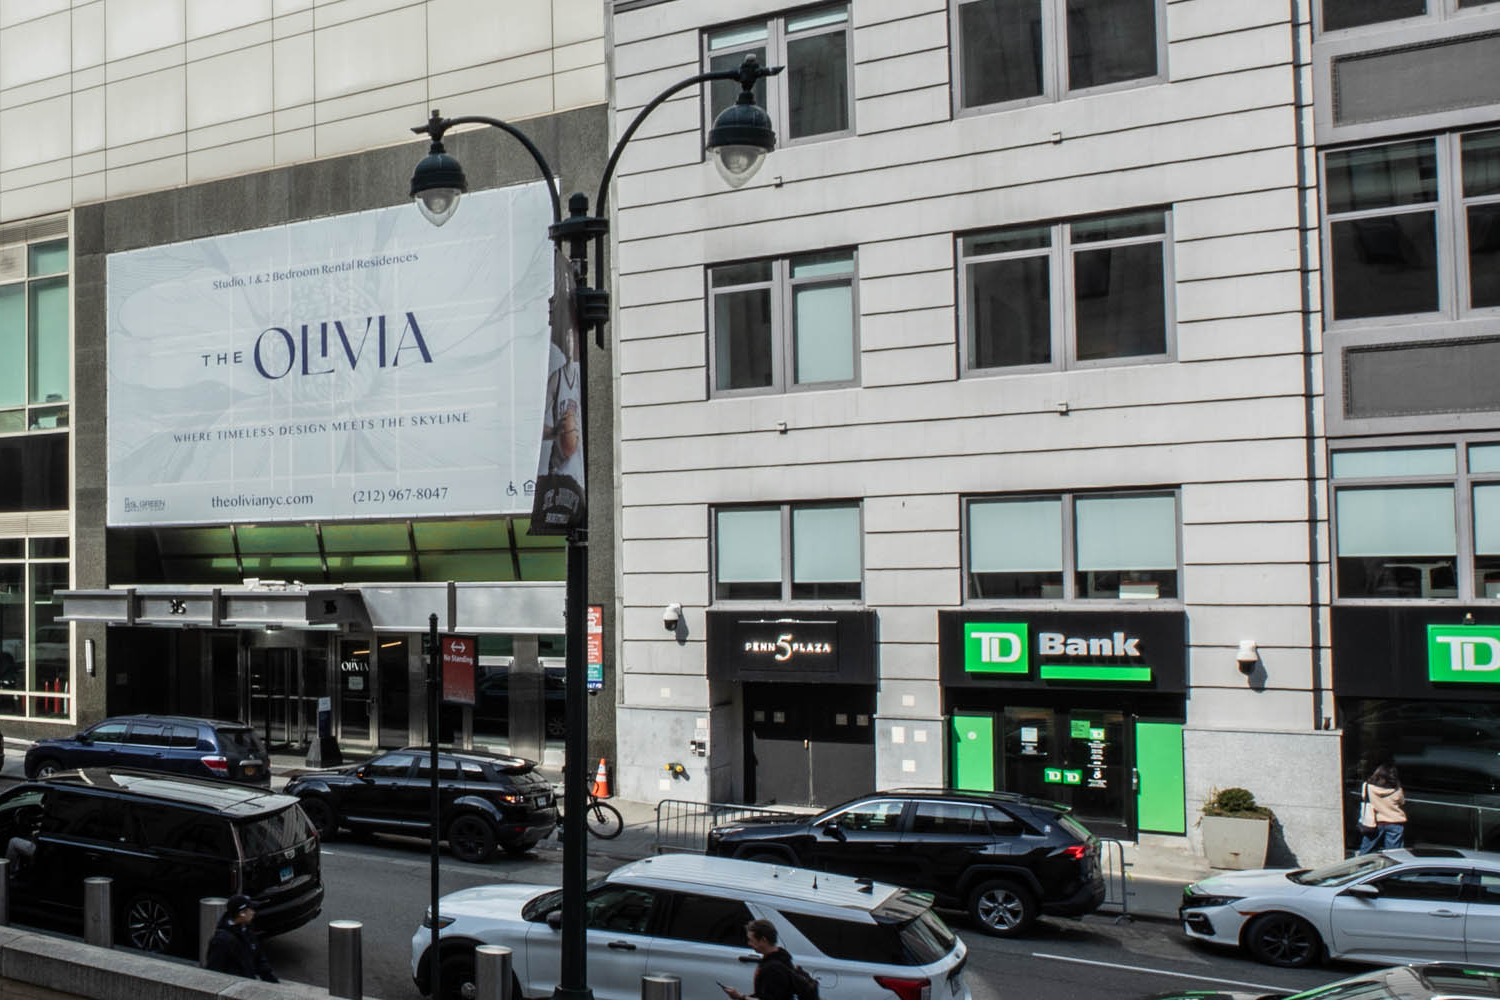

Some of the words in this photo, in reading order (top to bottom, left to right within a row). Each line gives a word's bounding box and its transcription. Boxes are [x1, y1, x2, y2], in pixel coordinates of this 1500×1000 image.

[212, 277, 247, 290] Studio,
[254, 274, 263, 284] &
[264, 273, 271, 283] 2
[272, 267, 320, 282] Bedroom
[321, 260, 355, 275] Rental
[357, 252, 419, 270] Residences
[201, 351, 244, 367] THE
[253, 311, 434, 380] OLIVIA
[173, 431, 212, 443] WHERE
[217, 427, 275, 441] TIMELESS
[278, 423, 328, 437] DESIGN
[331, 419, 375, 432] MEETS
[380, 416, 405, 429] THE
[411, 411, 470, 427] SKYLINE
[211, 492, 314, 509] theolivianyc.com
[352, 489, 386, 503] (212)
[388, 486, 449, 501] 967-8047
[451, 655, 474, 665] Standing
[744, 642, 776, 652] PENN
[774, 633, 793, 661] 5
[792, 642, 832, 653] PLAZA
[970, 631, 1022, 663] TD
[1038, 631, 1141, 657] Bank
[1435, 636, 1500, 671] TD
